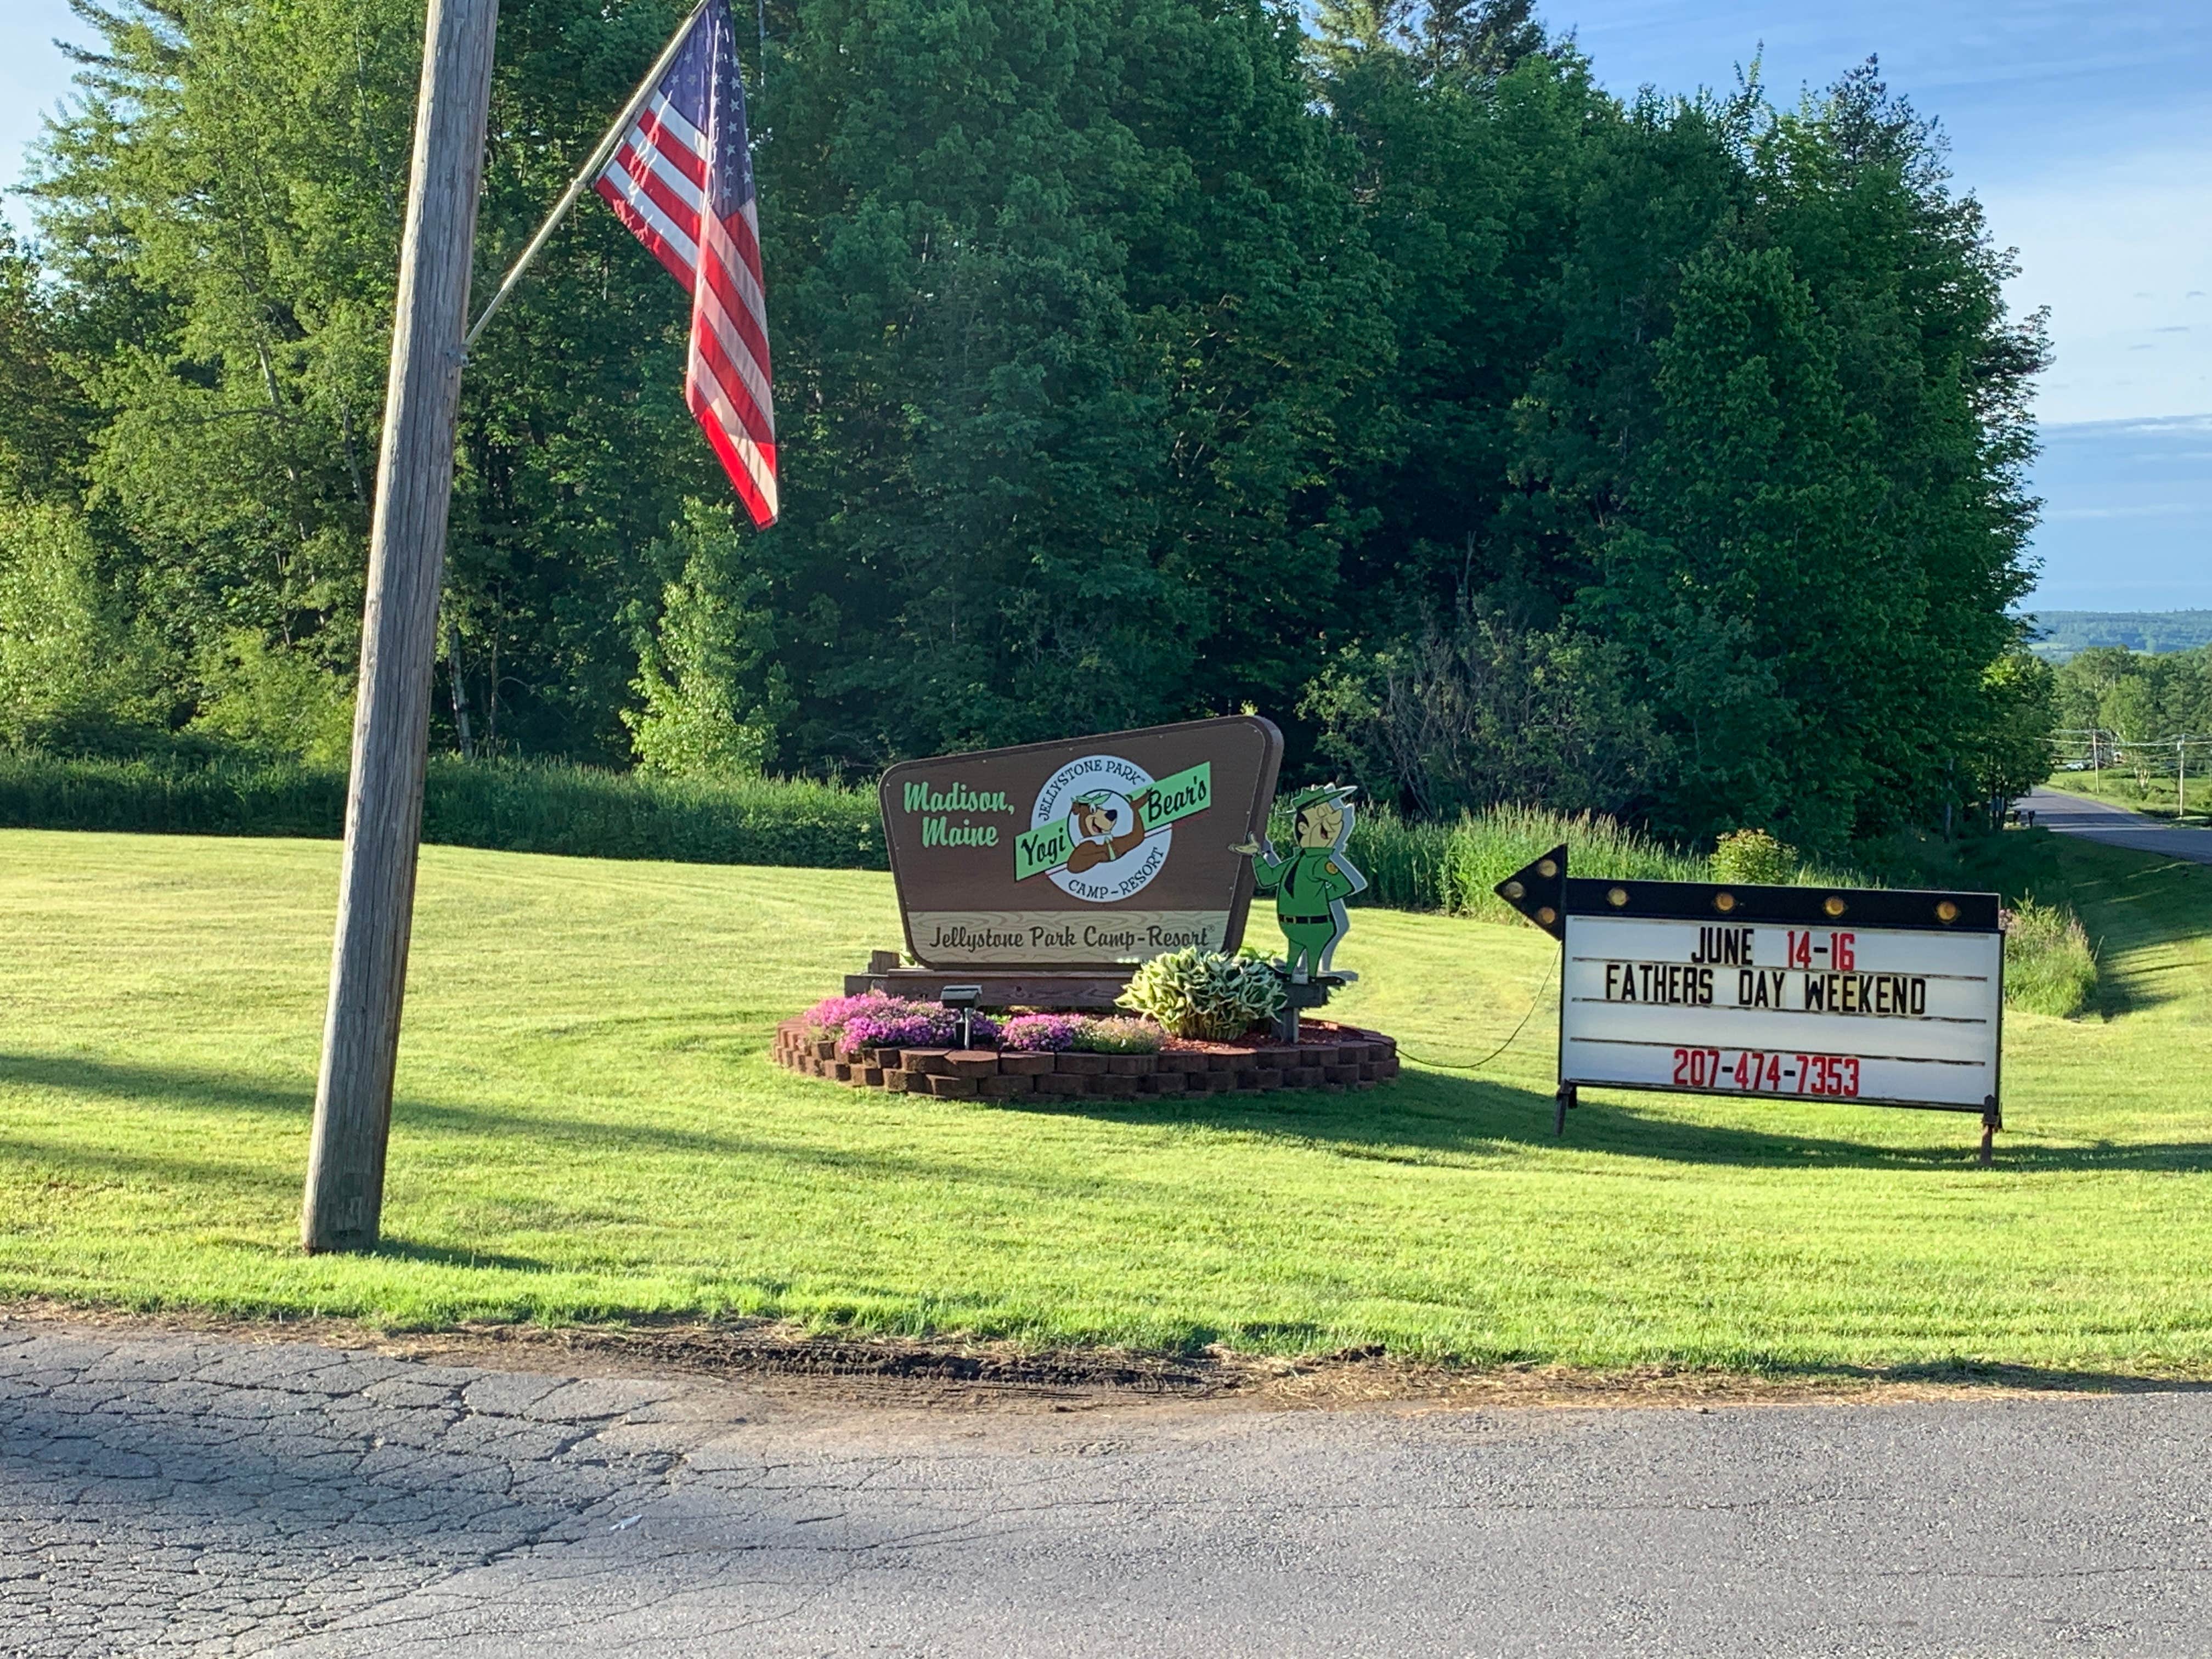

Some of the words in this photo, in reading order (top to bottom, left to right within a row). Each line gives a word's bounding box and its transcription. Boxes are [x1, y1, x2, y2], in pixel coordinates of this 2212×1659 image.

[904, 782, 1014, 815] Madison,
[1039, 759, 1102, 821] JELLYSTONE
[1105, 761, 1141, 785] PARK
[922, 816, 999, 848] Maine
[1021, 827, 1066, 866] Yogi
[1147, 776, 1207, 822] Bear's
[929, 926, 1023, 953] Jellystone
[1029, 926, 1076, 947] Park
[1084, 926, 1209, 951] Camp-Resort
[1691, 927, 1754, 966] JUNE
[1787, 930, 1855, 971] 14-16
[1606, 964, 1713, 1005] FATHERS
[1739, 969, 1785, 1007] DAY
[1805, 974, 1926, 1015] WEEKEND
[1673, 1048, 1859, 1097] 207-474-7353
